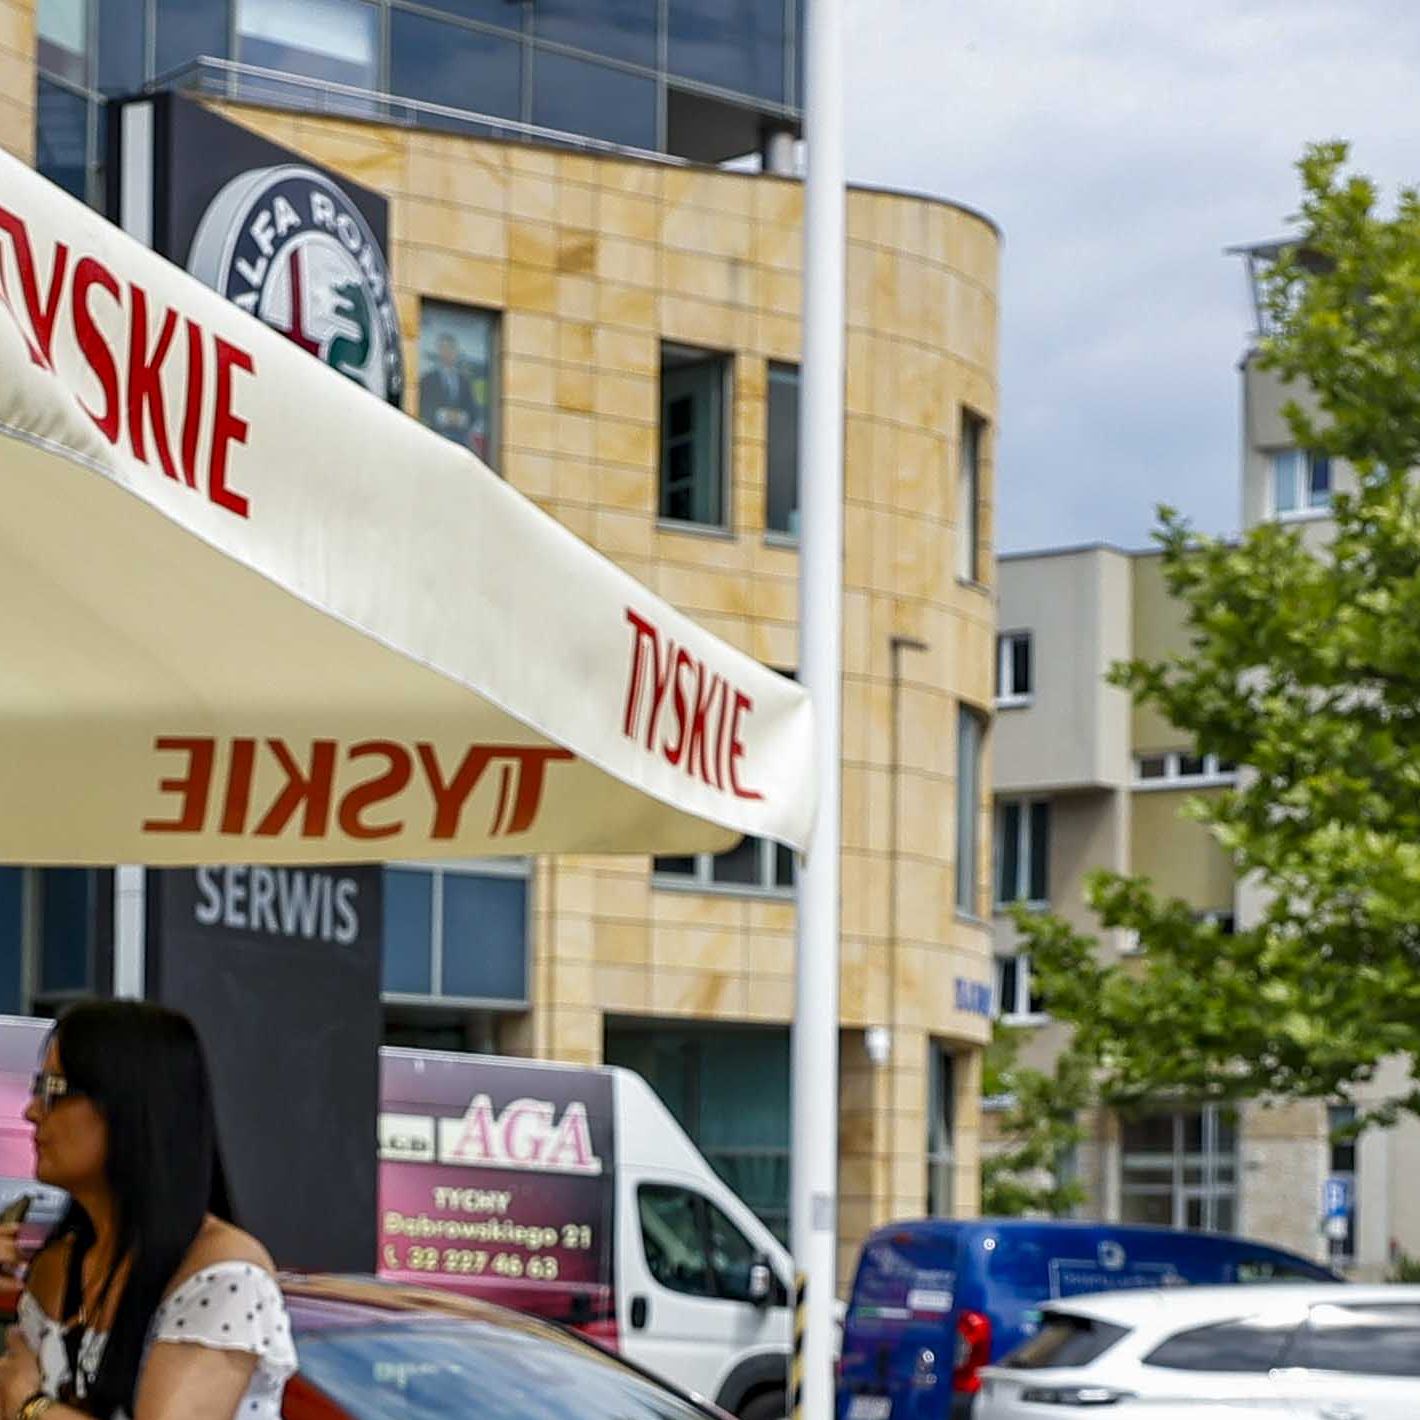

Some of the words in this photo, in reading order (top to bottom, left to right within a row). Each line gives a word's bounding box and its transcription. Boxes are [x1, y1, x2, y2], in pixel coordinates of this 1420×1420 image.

[624, 608, 764, 801] TYSKIE
[196, 864, 358, 944] SERWIS
[453, 1097, 598, 1170] AGA
[433, 1186, 513, 1215] TYCHY
